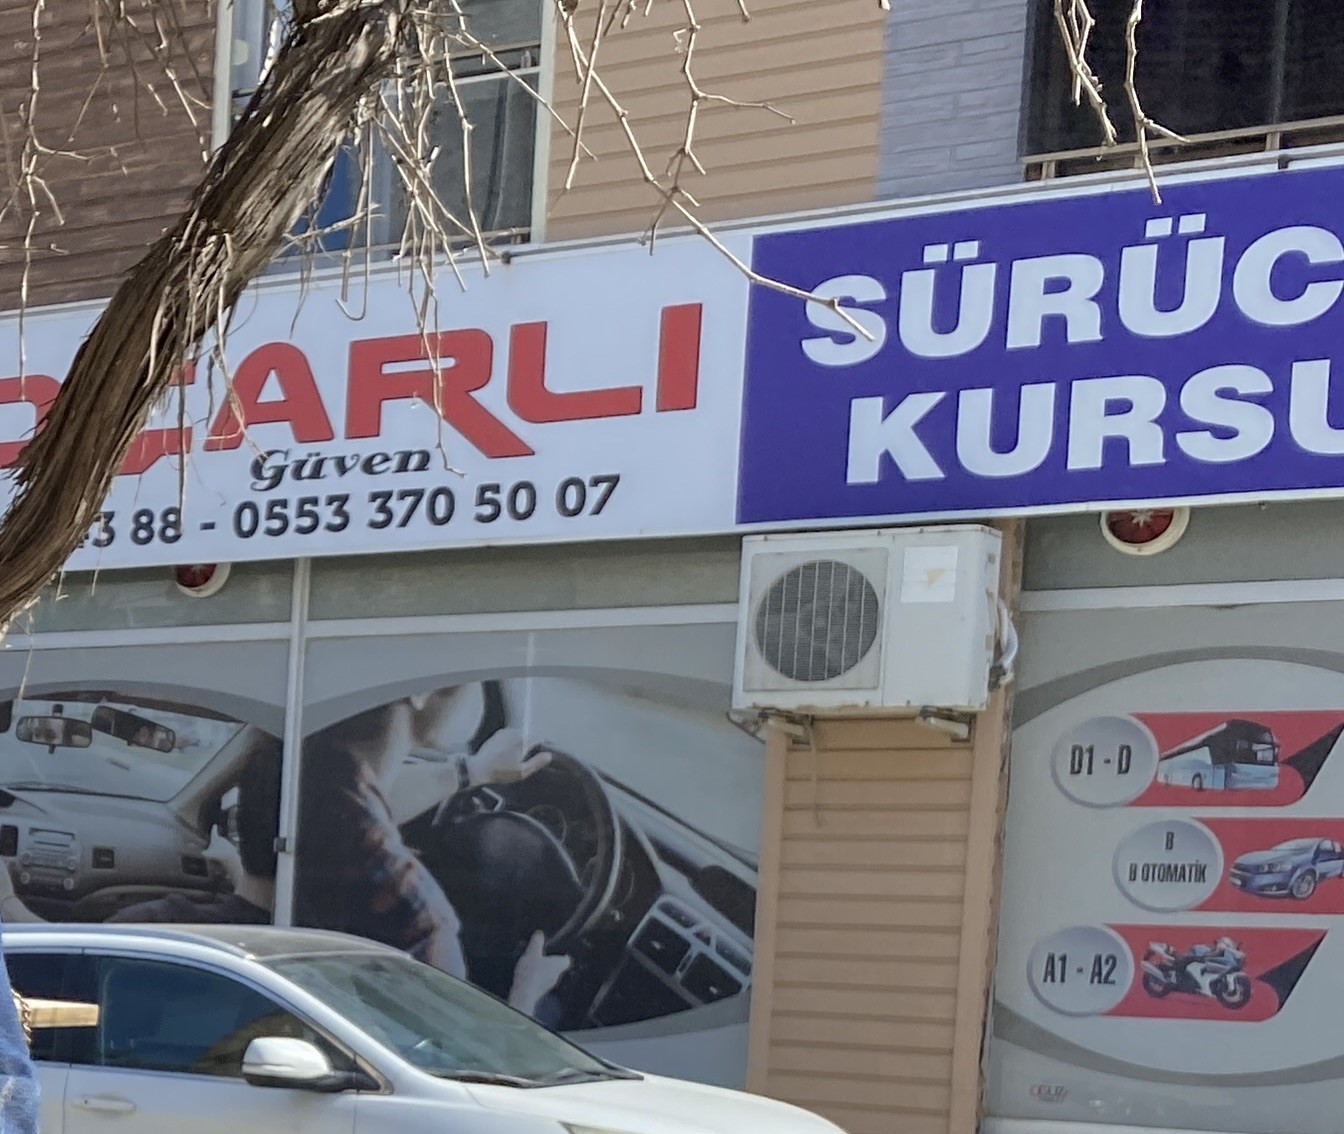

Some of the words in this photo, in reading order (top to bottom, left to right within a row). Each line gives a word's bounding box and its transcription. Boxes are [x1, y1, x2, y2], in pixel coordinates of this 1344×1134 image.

[800, 213, 1344, 366] SÜRÜC
[845, 358, 1344, 485] KURSU
[250, 448, 432, 491] Güven
[130, 506, 182, 546] 88
[232, 493, 351, 539] 0553
[367, 486, 457, 529] 370
[473, 479, 538, 525] 50
[554, 473, 622, 518] 07
[1070, 743, 1095, 775] D1
[1117, 743, 1132, 775] D
[1165, 831, 1175, 850] B
[1141, 859, 1207, 883] OTOMATİK
[1043, 951, 1067, 984] A1
[1089, 953, 1118, 985] A2
